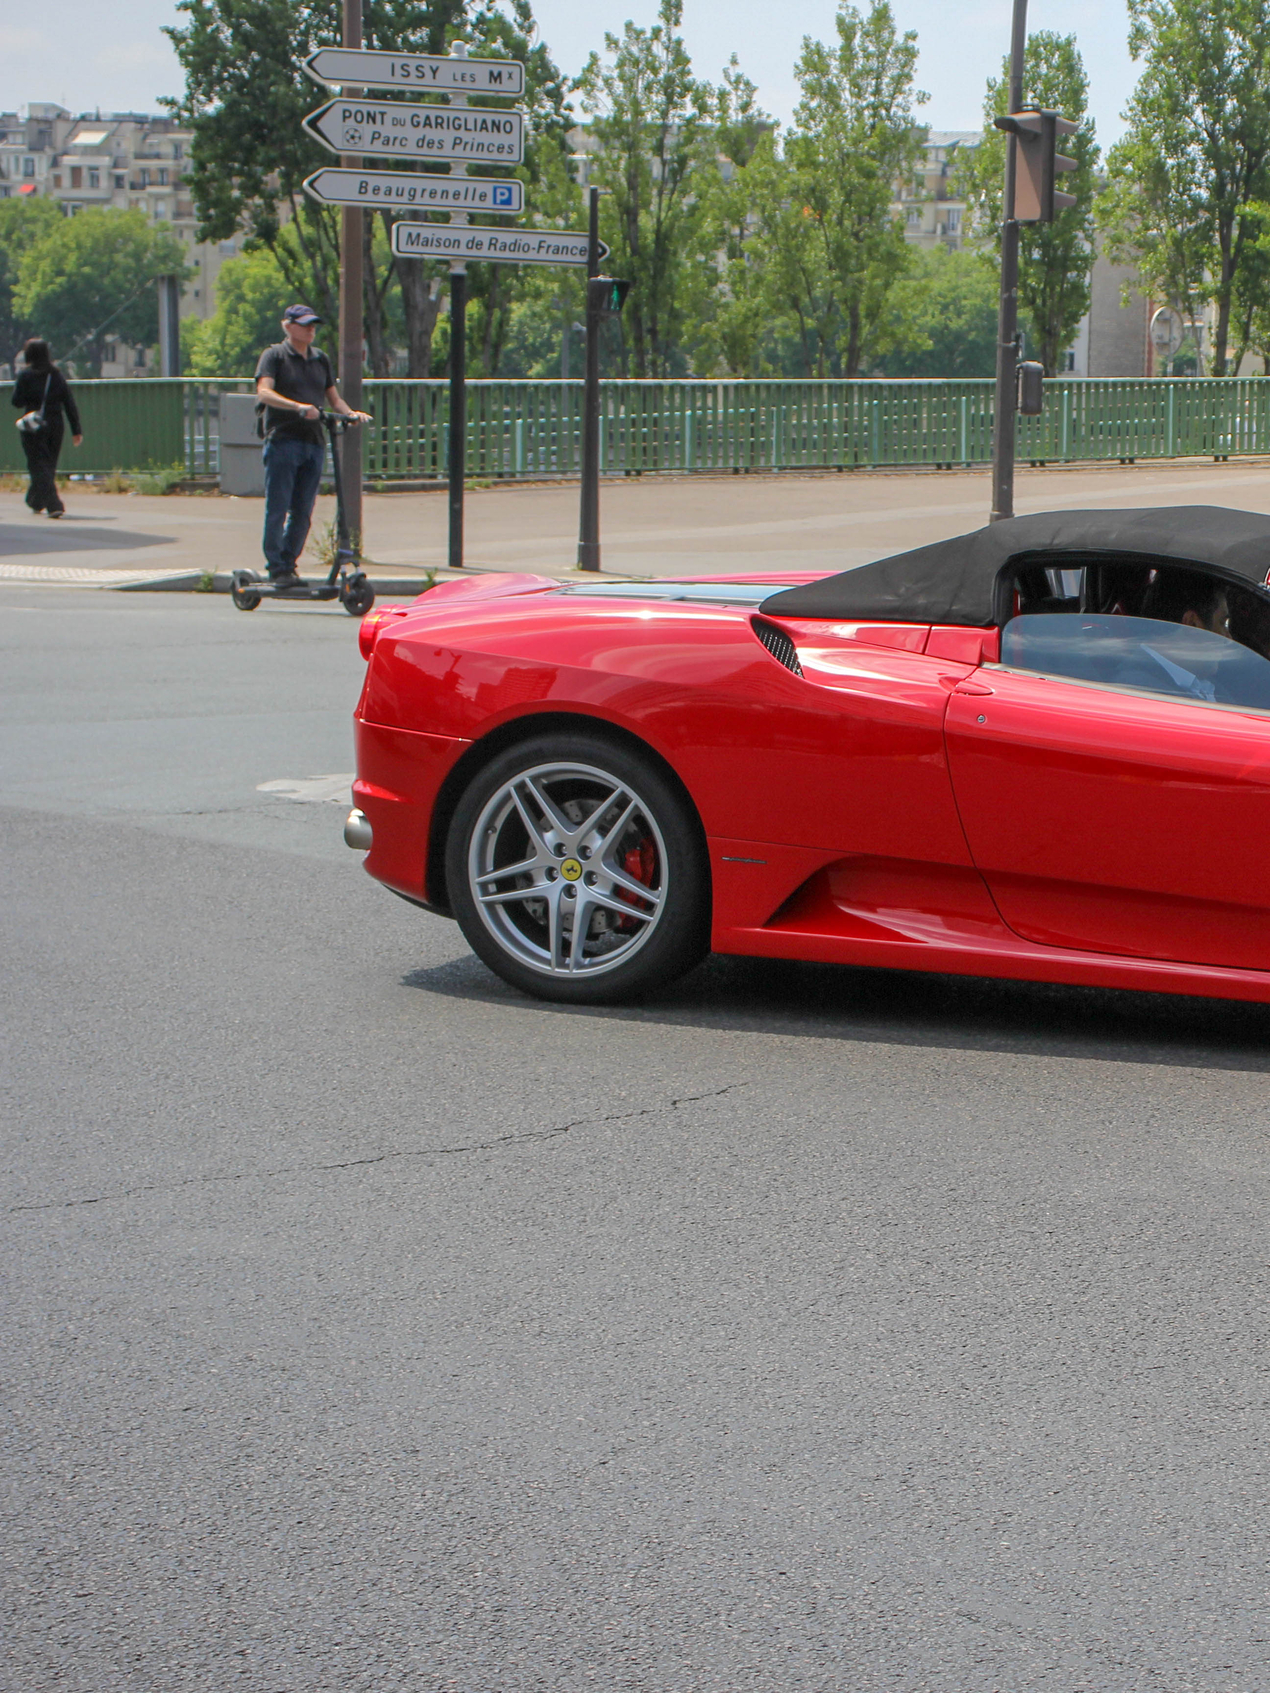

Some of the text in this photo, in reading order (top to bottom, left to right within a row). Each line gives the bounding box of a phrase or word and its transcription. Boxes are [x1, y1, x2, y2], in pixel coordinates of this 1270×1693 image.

[390, 61, 440, 80] ISSY
[452, 71, 477, 83] LES
[341, 108, 514, 135] PONT DU GARIGLIANO
[369, 130, 515, 155] Parc des Princes
[357, 179, 488, 202] Beaugrenelle
[405, 231, 588, 257] Maison de Radio-France
